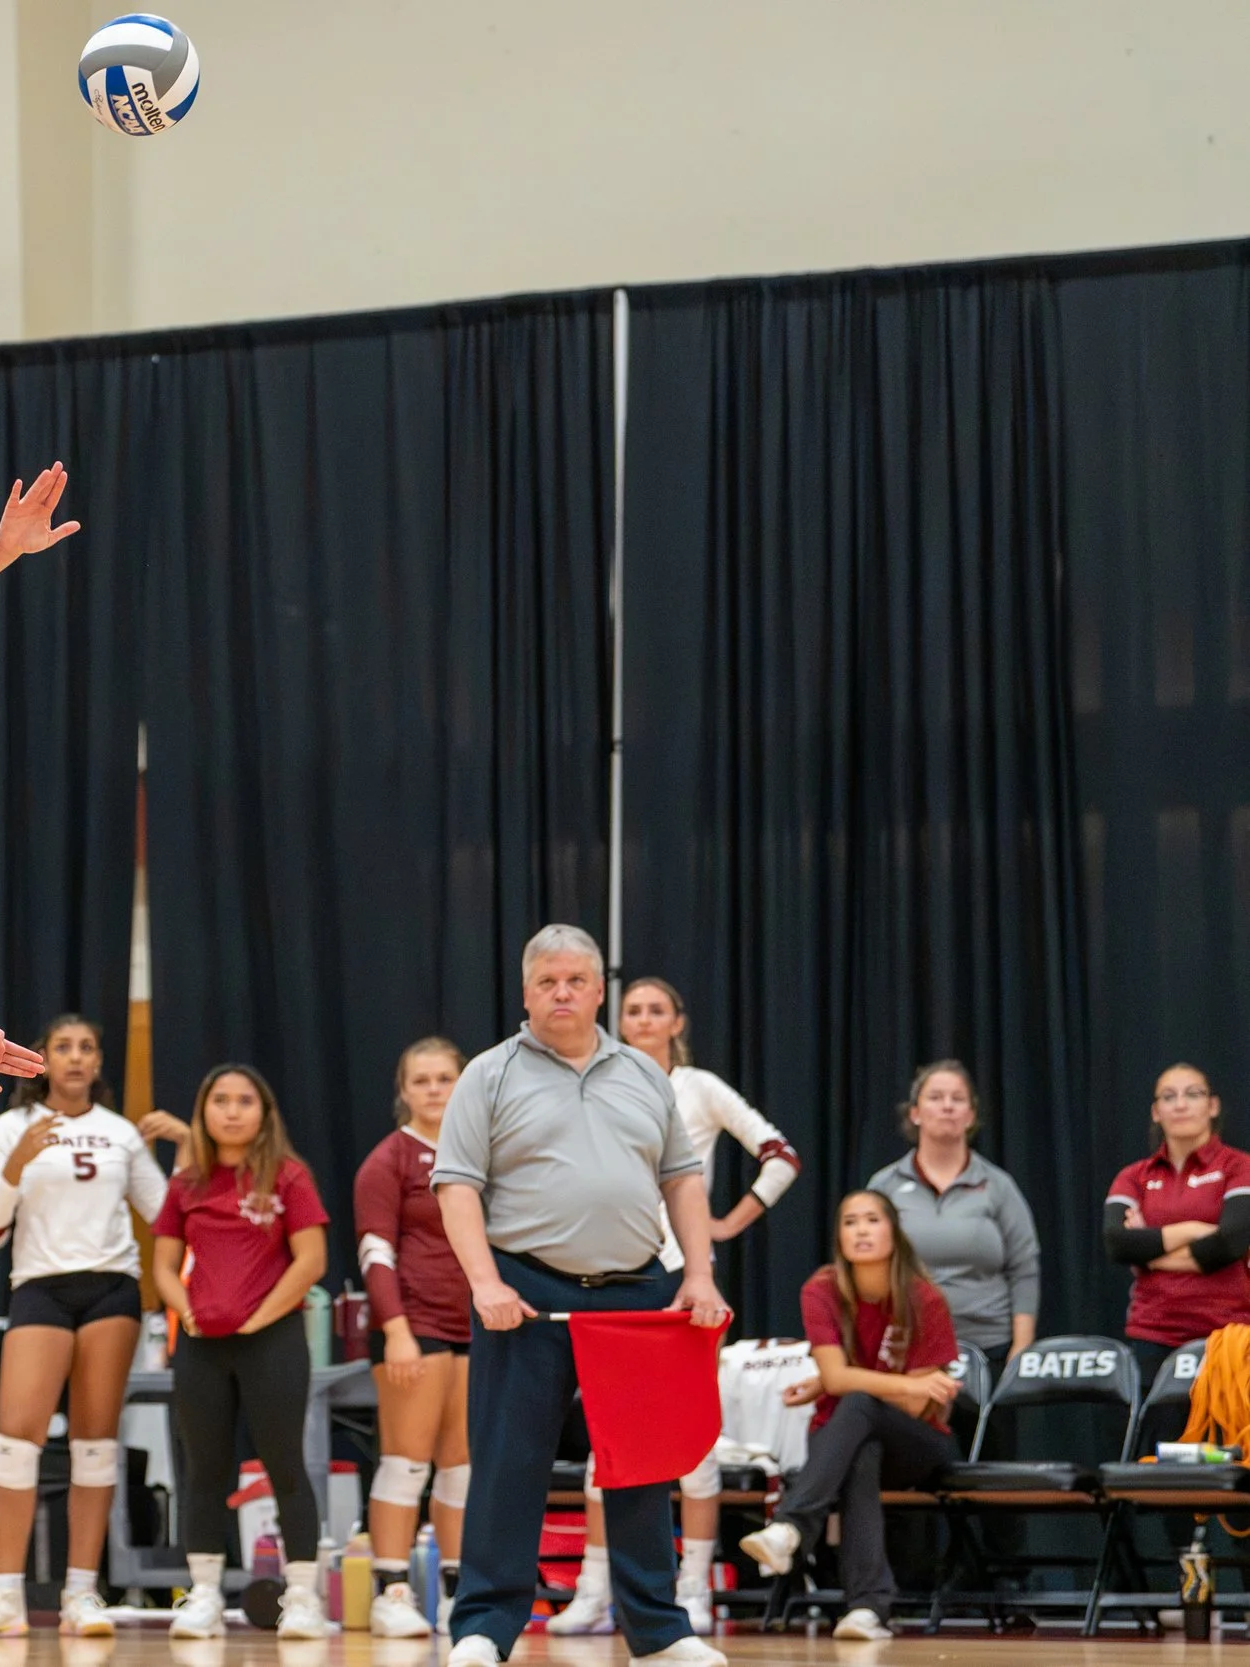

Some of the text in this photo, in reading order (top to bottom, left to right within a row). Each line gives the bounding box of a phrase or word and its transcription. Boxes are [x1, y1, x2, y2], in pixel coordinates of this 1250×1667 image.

[131, 82, 166, 132] molten
[72, 1152, 97, 1182] 5
[1017, 1349, 1119, 1379] BATES
